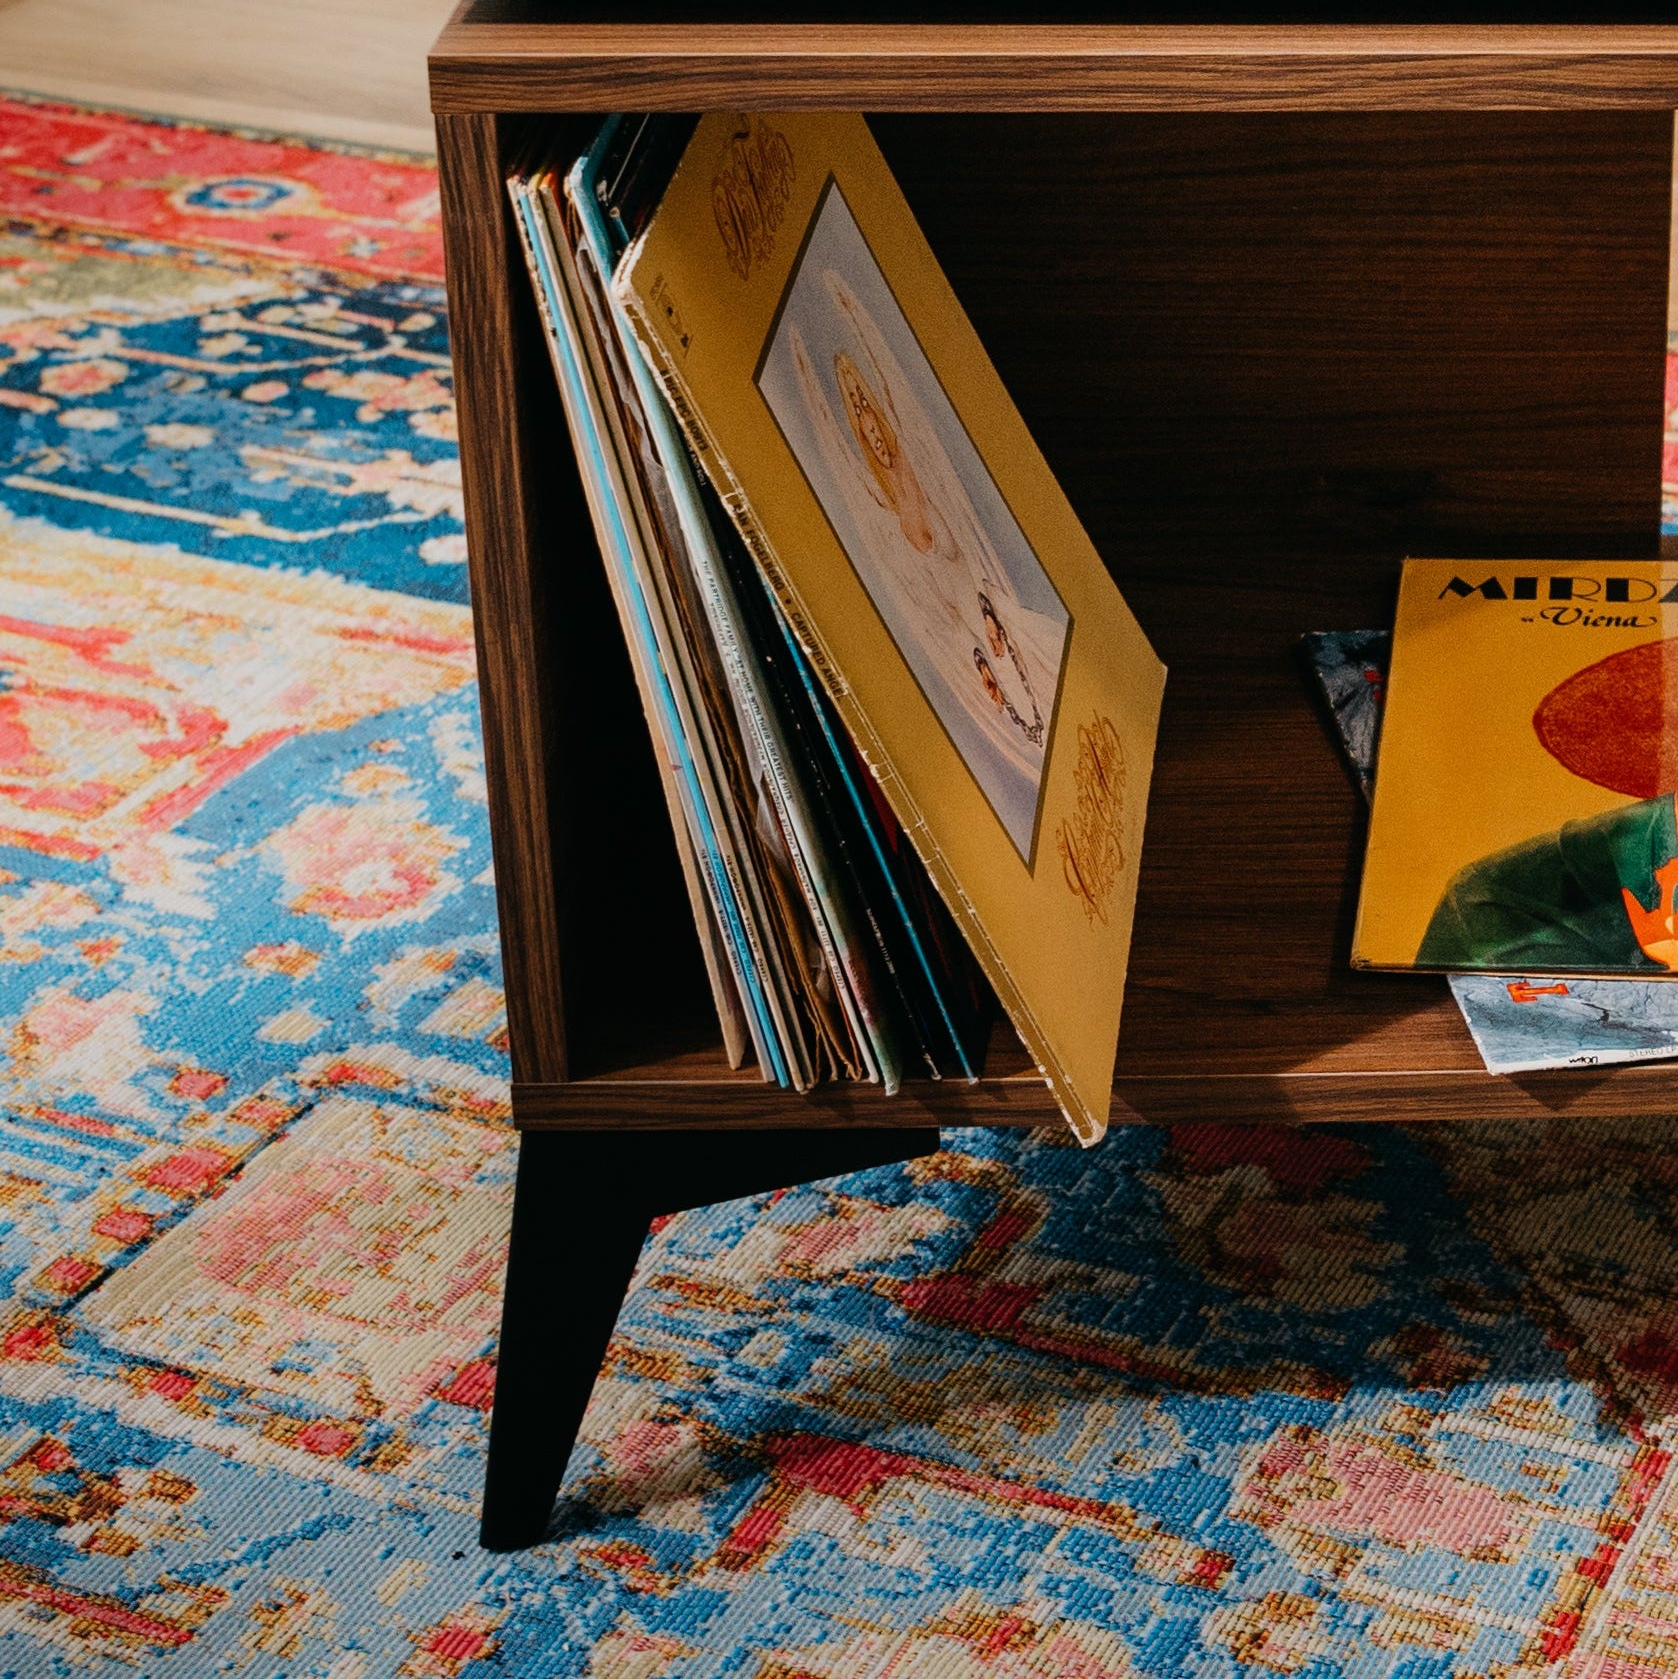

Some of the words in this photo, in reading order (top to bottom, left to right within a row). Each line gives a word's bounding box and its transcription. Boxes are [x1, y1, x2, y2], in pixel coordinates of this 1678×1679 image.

[705, 576, 730, 623] PARTRIDGE
[764, 739, 788, 783] GREATEST
[744, 526, 786, 592] FOGELBERG
[788, 609, 827, 666] CAPTURED
[819, 664, 847, 703] ANGEL
